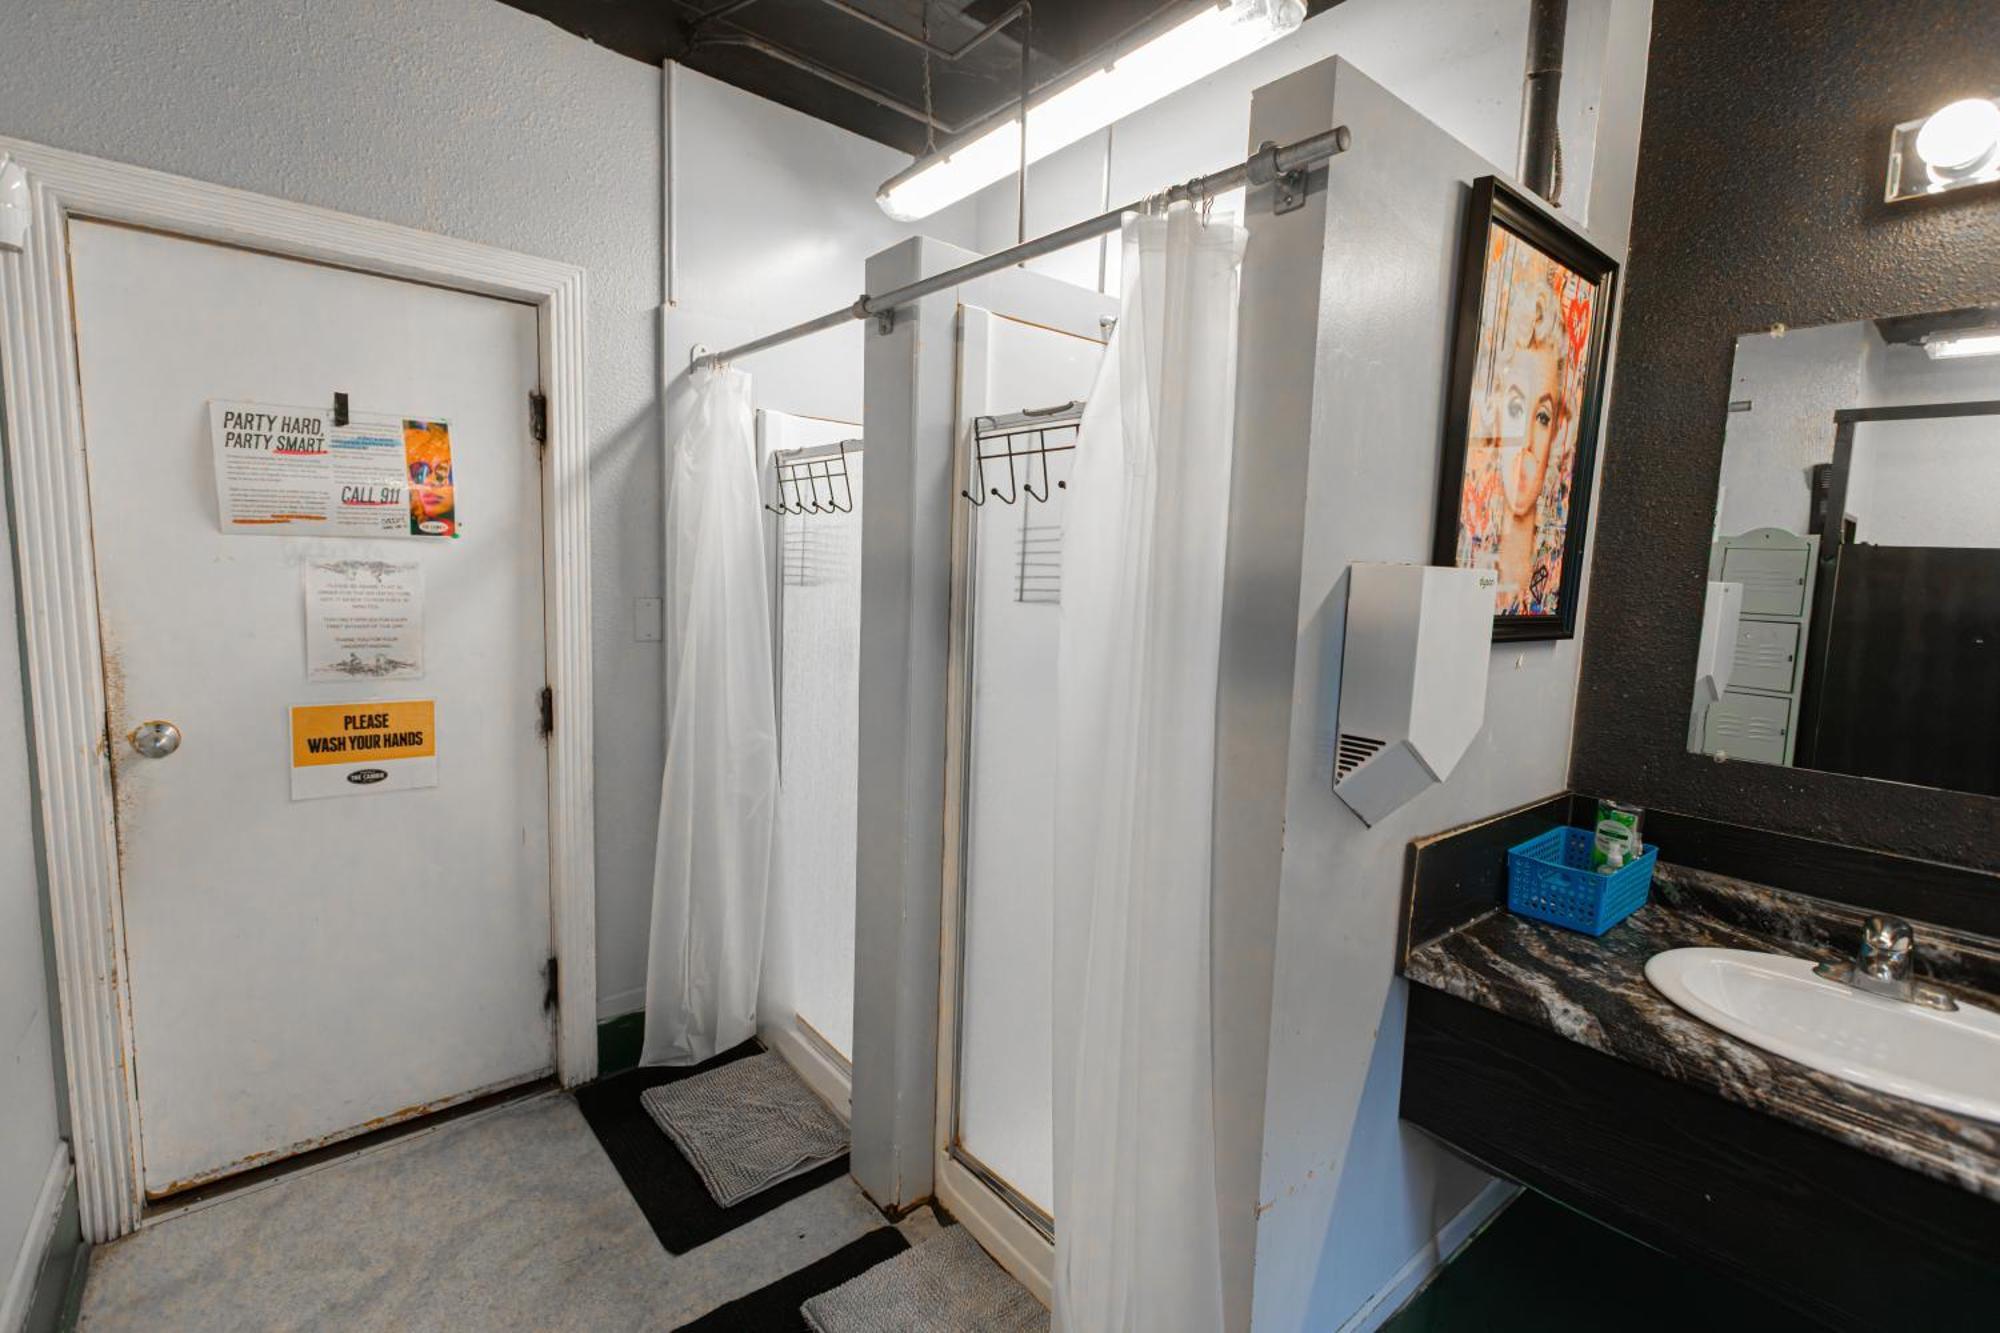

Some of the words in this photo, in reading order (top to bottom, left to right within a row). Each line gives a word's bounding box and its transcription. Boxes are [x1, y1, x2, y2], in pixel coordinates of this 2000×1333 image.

[223, 411, 278, 431] PARTY
[280, 415, 324, 437] HARD,
[224, 431, 273, 450] PARTY
[341, 486, 375, 503] CALL
[380, 488, 401, 504] 911
[344, 713, 390, 731] PLEASE
[307, 737, 346, 753] WASH
[348, 733, 381, 751] YOUR
[383, 731, 423, 747] HANDS
